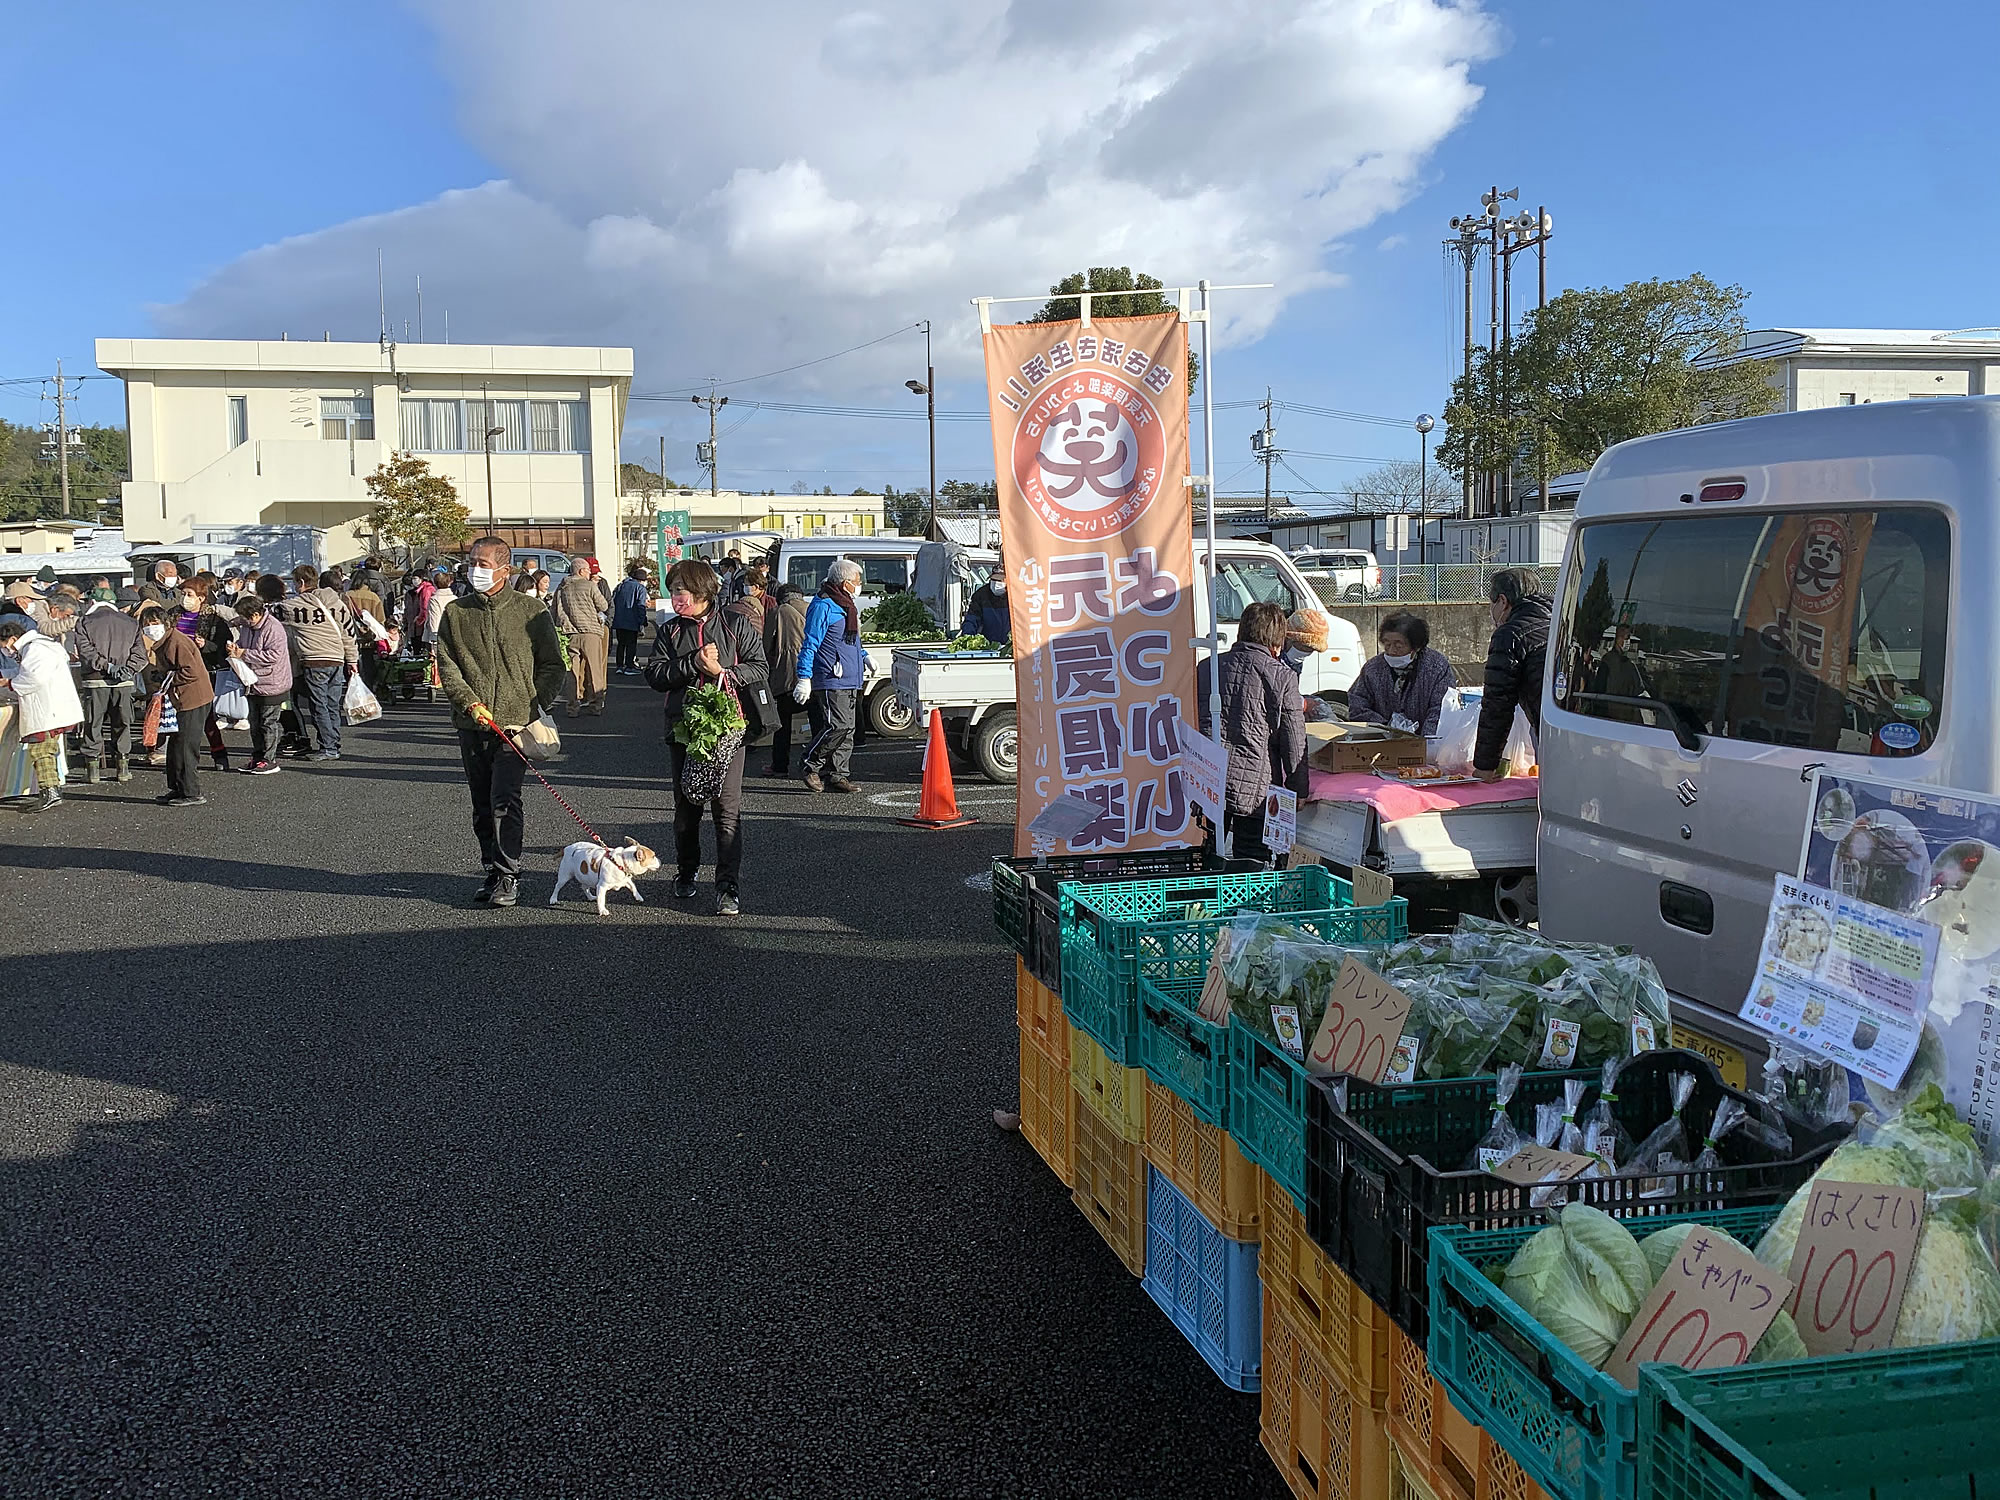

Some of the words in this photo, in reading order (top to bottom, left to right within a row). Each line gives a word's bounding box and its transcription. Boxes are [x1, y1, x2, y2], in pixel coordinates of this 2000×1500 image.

[1342, 966, 1406, 1021] クレソン
[1313, 1002, 1385, 1083] 300
[1810, 1191, 1917, 1231] はくさい
[1682, 1238, 1773, 1311] きゃべつ
[1791, 1245, 1896, 1338] 100
